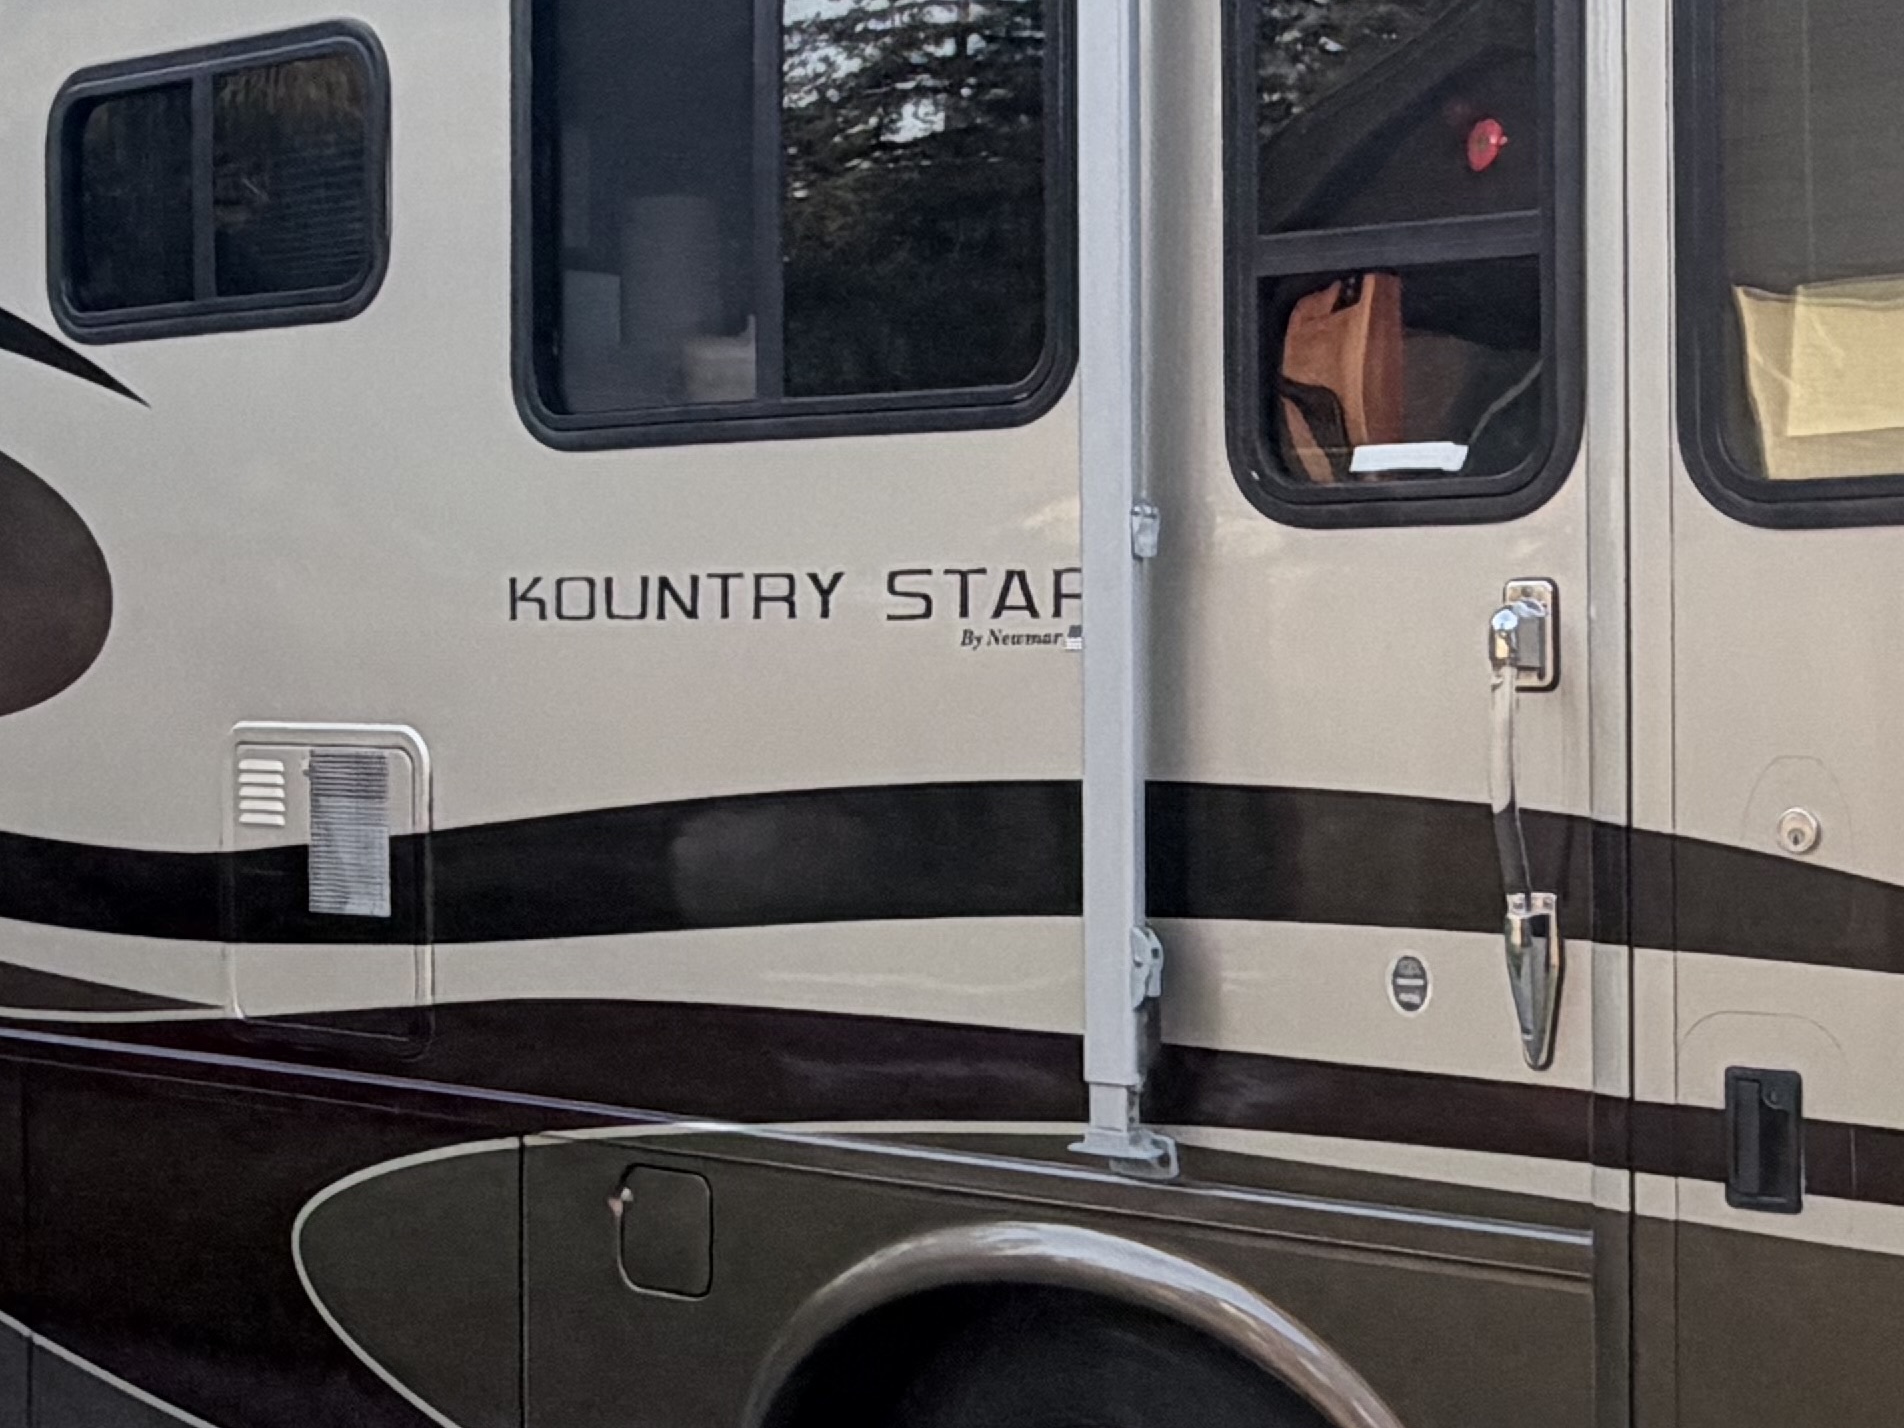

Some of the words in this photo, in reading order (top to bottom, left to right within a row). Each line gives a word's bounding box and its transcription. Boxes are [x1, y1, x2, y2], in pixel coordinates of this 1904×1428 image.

[509, 571, 845, 621] KOUNTRY
[960, 628, 983, 651] By
[986, 628, 1064, 647] Newmar
